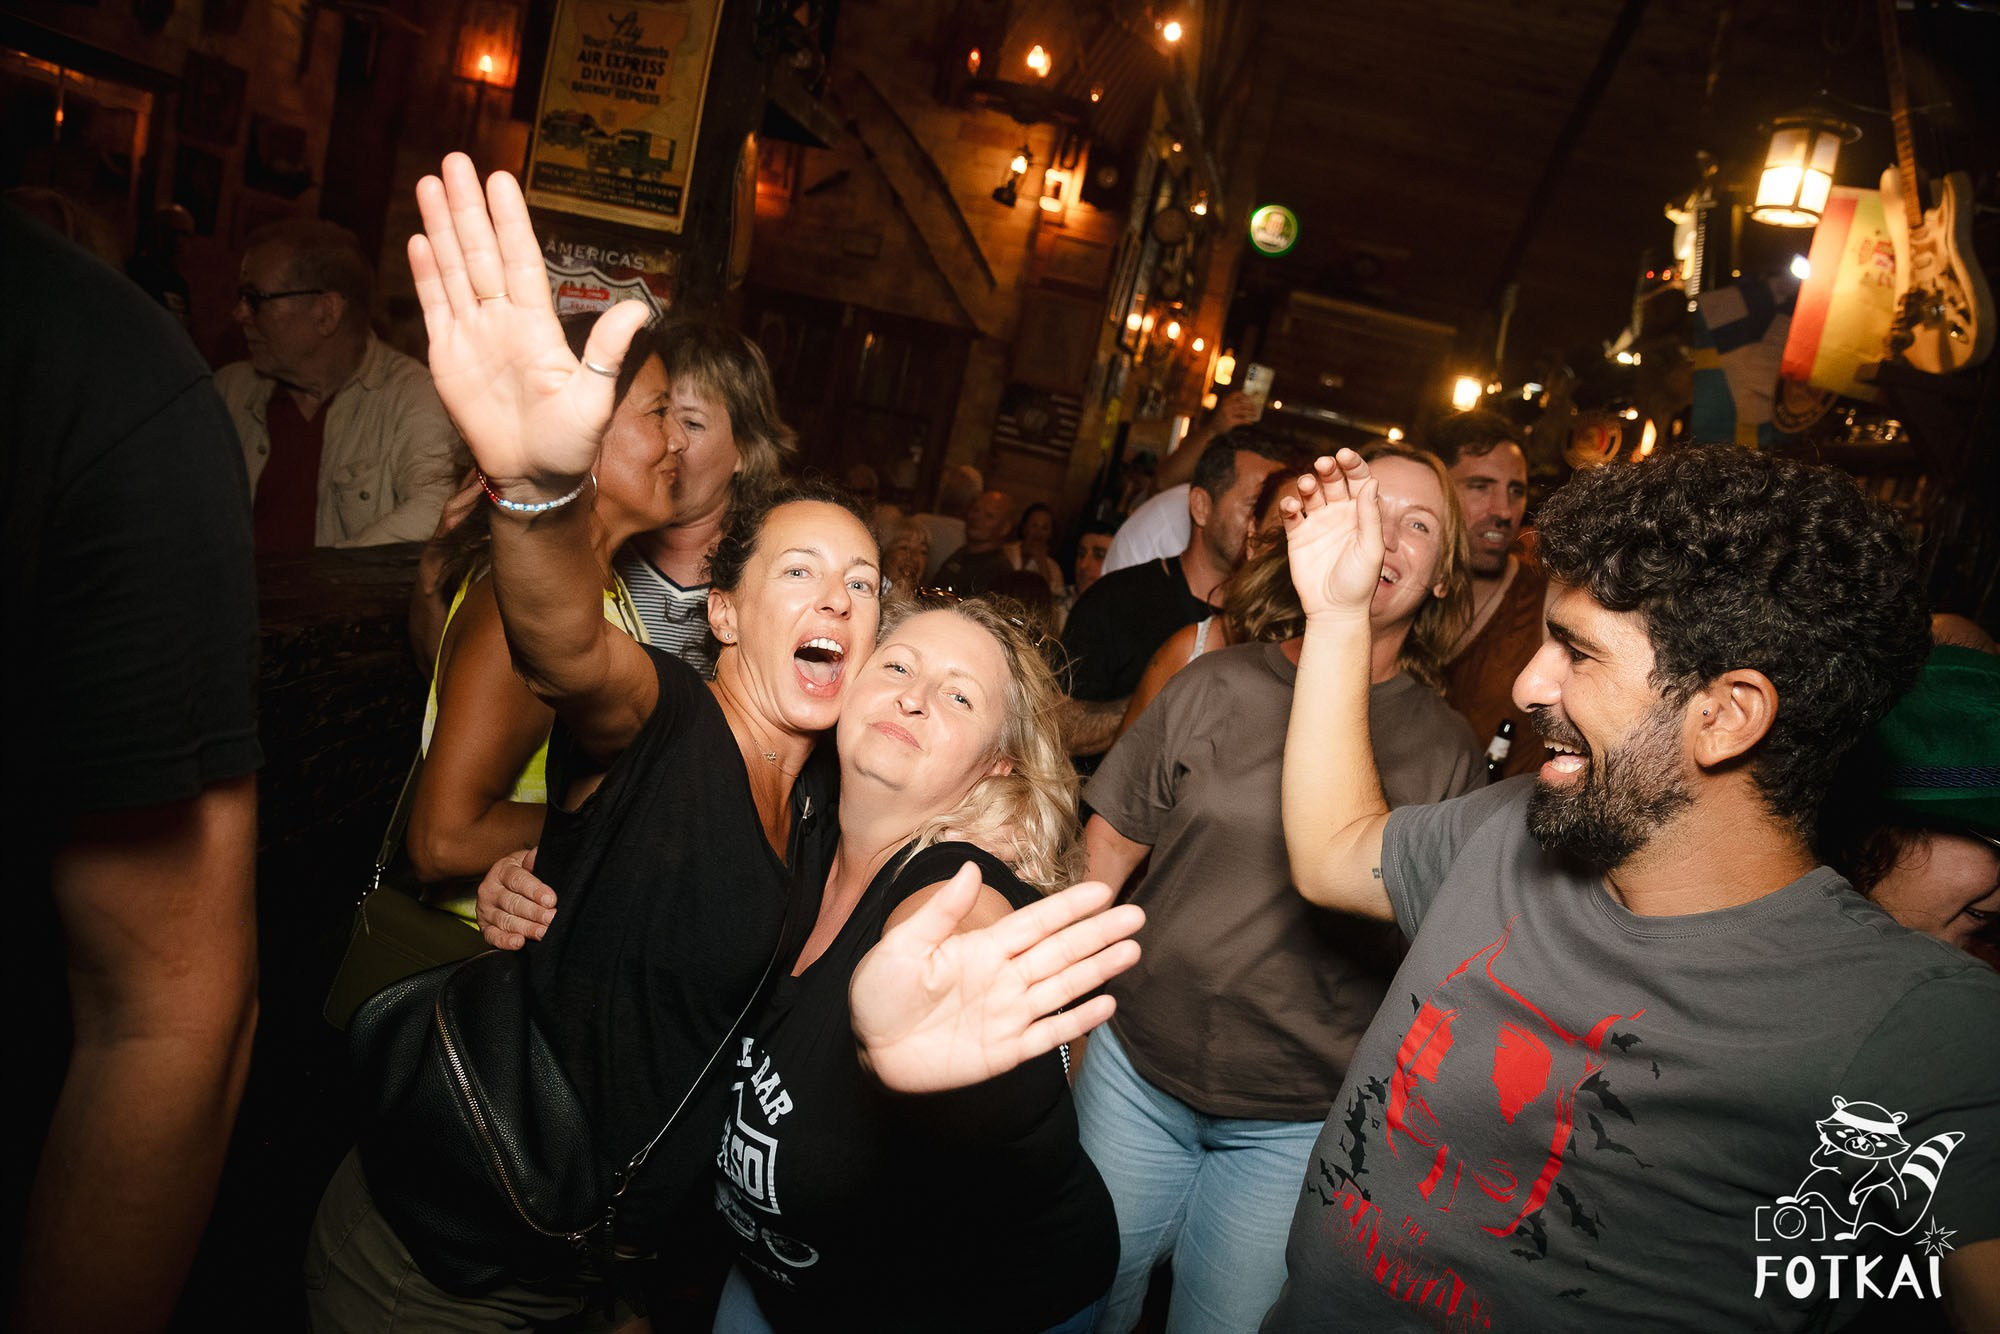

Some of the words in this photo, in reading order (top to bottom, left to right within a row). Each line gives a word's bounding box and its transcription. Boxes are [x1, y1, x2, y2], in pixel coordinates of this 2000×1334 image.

[577, 49, 602, 65] AIR
[606, 53, 665, 76] EXPRESS
[581, 67, 656, 91] DIVISION
[545, 240, 645, 271] AMERICA'S
[1402, 1216, 1429, 1247] THE
